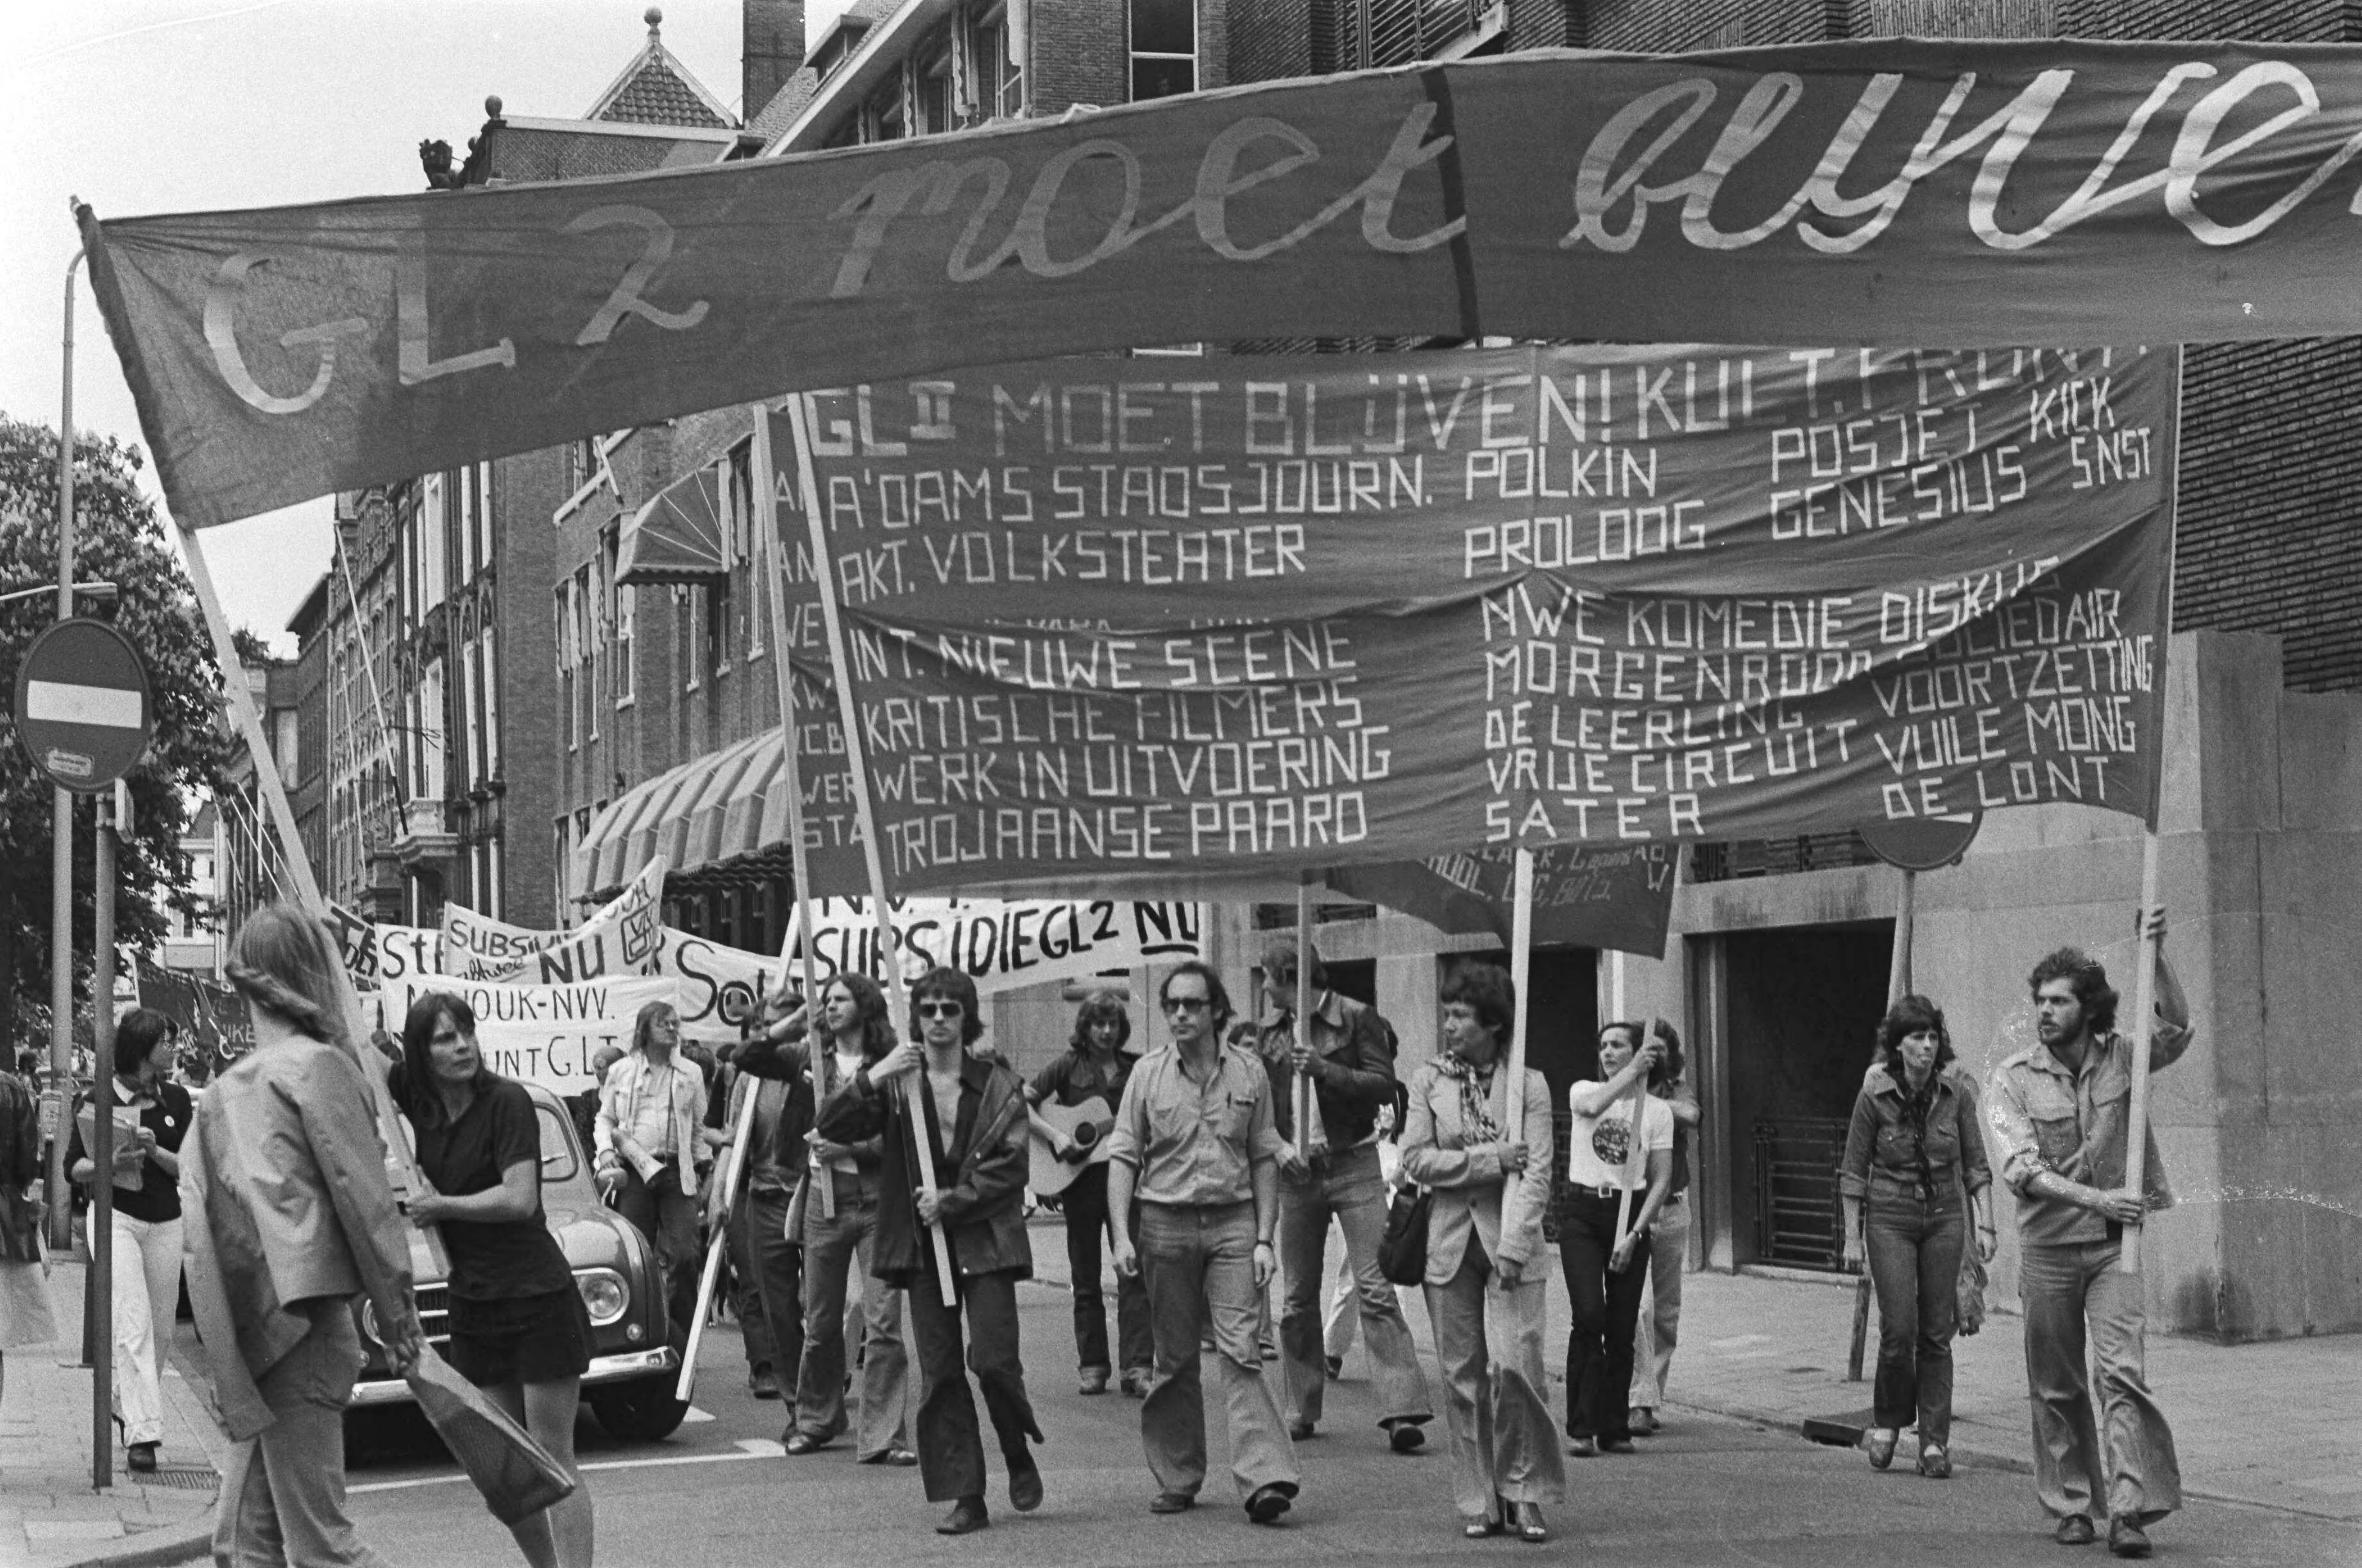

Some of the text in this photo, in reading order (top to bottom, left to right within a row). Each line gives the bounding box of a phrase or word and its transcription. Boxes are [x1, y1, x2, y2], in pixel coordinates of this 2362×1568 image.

[558, 204, 709, 346] 2
[992, 382, 1219, 456] MOET
[2029, 375, 2116, 444] KICK
[1465, 446, 1657, 500] POLKIN
[1770, 445, 2027, 540] GENESIUS
[923, 523, 1306, 584] VOLKSTEATER
[1465, 499, 1706, 578] PROLOOG
[848, 627, 924, 682] INT.
[1164, 621, 1357, 686] SCENE
[1627, 596, 1853, 650] KOMEDIE
[1871, 635, 2155, 718] VOORTZETTING
[862, 675, 1363, 756] KRITISCHE FILMERS
[1484, 698, 1804, 751] DE LEERLING
[1873, 696, 2137, 775] VUILE MONG
[873, 725, 1391, 805] WERK IN UITVOERING
[1631, 719, 1858, 793] CIRCUIT
[1881, 755, 2110, 821] DE LONT
[885, 804, 1172, 877] TROJAANSE
[1486, 793, 1705, 843] SATER
[538, 934, 605, 984] NU
